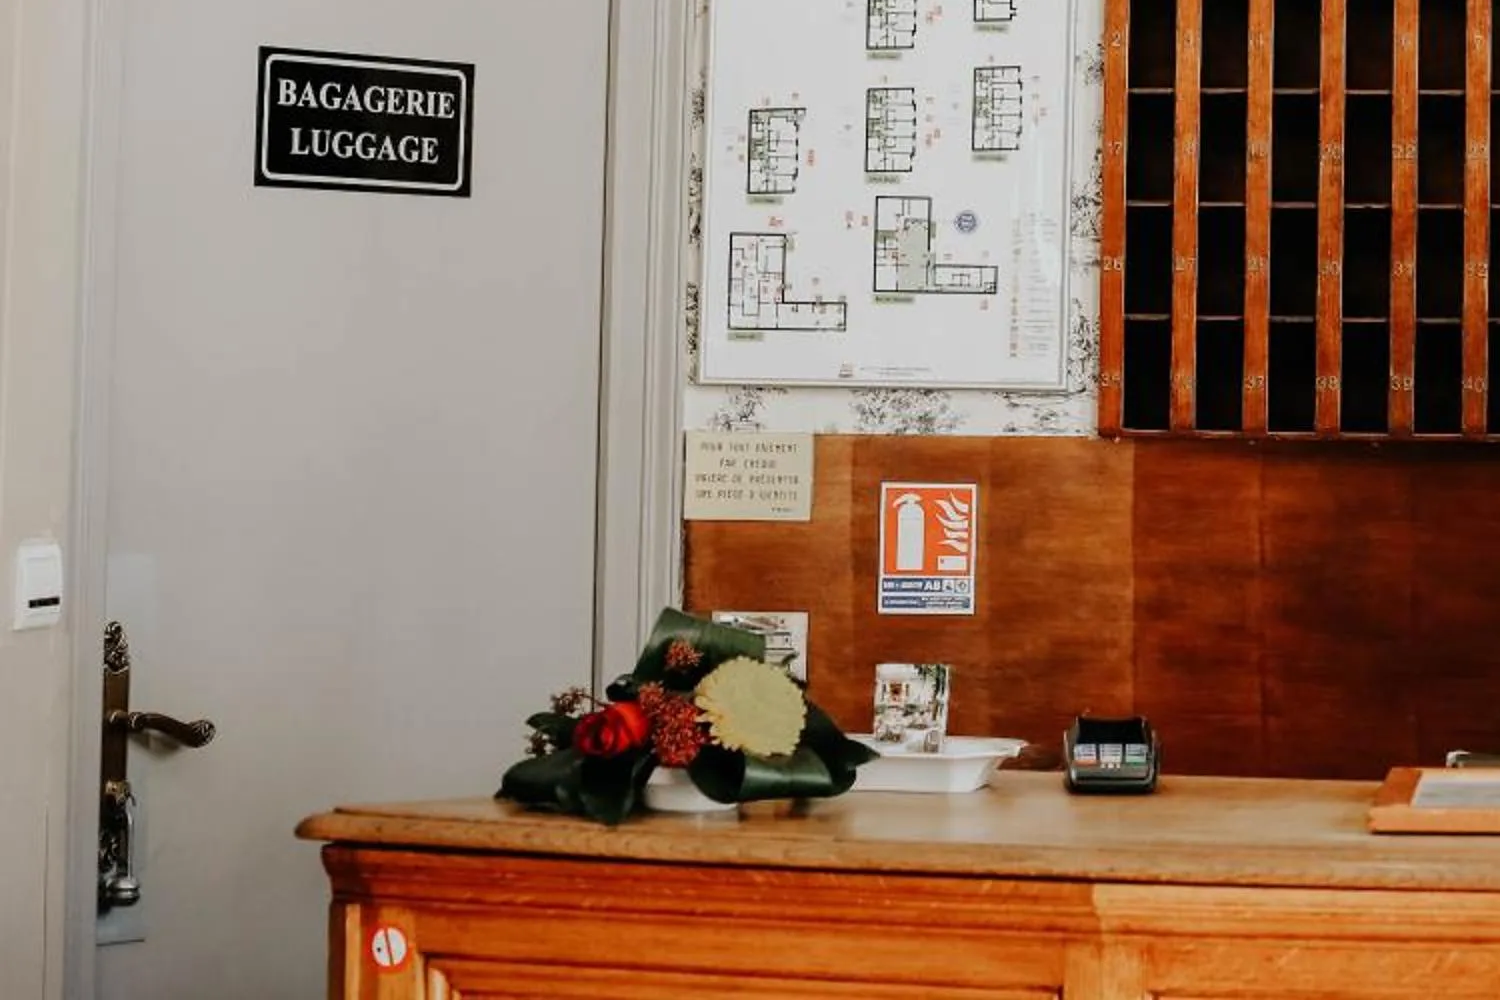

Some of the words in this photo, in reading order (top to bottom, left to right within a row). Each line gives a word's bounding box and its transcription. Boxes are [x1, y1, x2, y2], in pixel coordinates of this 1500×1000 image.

[277, 77, 456, 119] BAGAGERIE
[290, 127, 440, 165] LUGGAGE
[1103, 255, 1122, 272] 26
[1391, 375, 1413, 391] 39
[1463, 375, 1485, 393] 40
